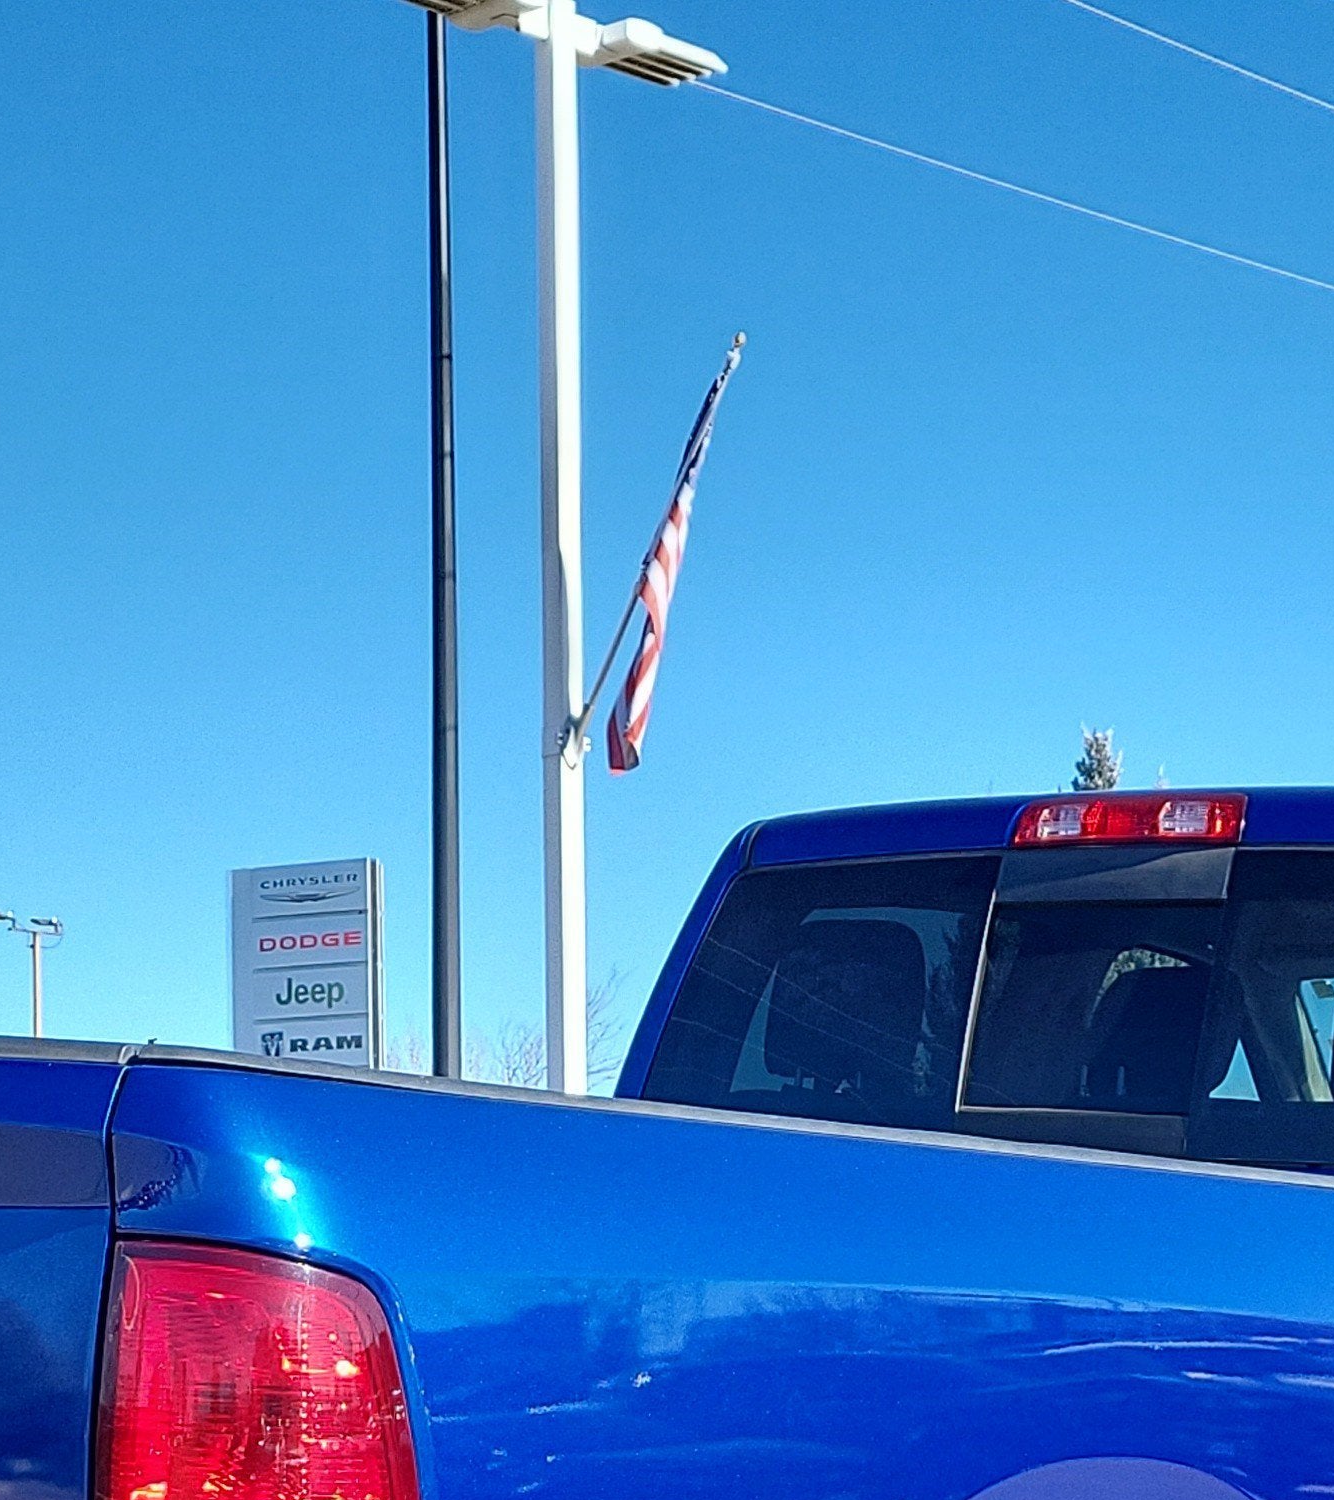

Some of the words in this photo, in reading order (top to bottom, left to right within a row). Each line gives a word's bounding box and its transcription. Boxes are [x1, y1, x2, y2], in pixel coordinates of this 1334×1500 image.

[260, 873, 358, 890] CHRYSLER
[259, 930, 362, 952] DODGE
[275, 977, 345, 1008] Jeep
[289, 1035, 363, 1052] RAM
